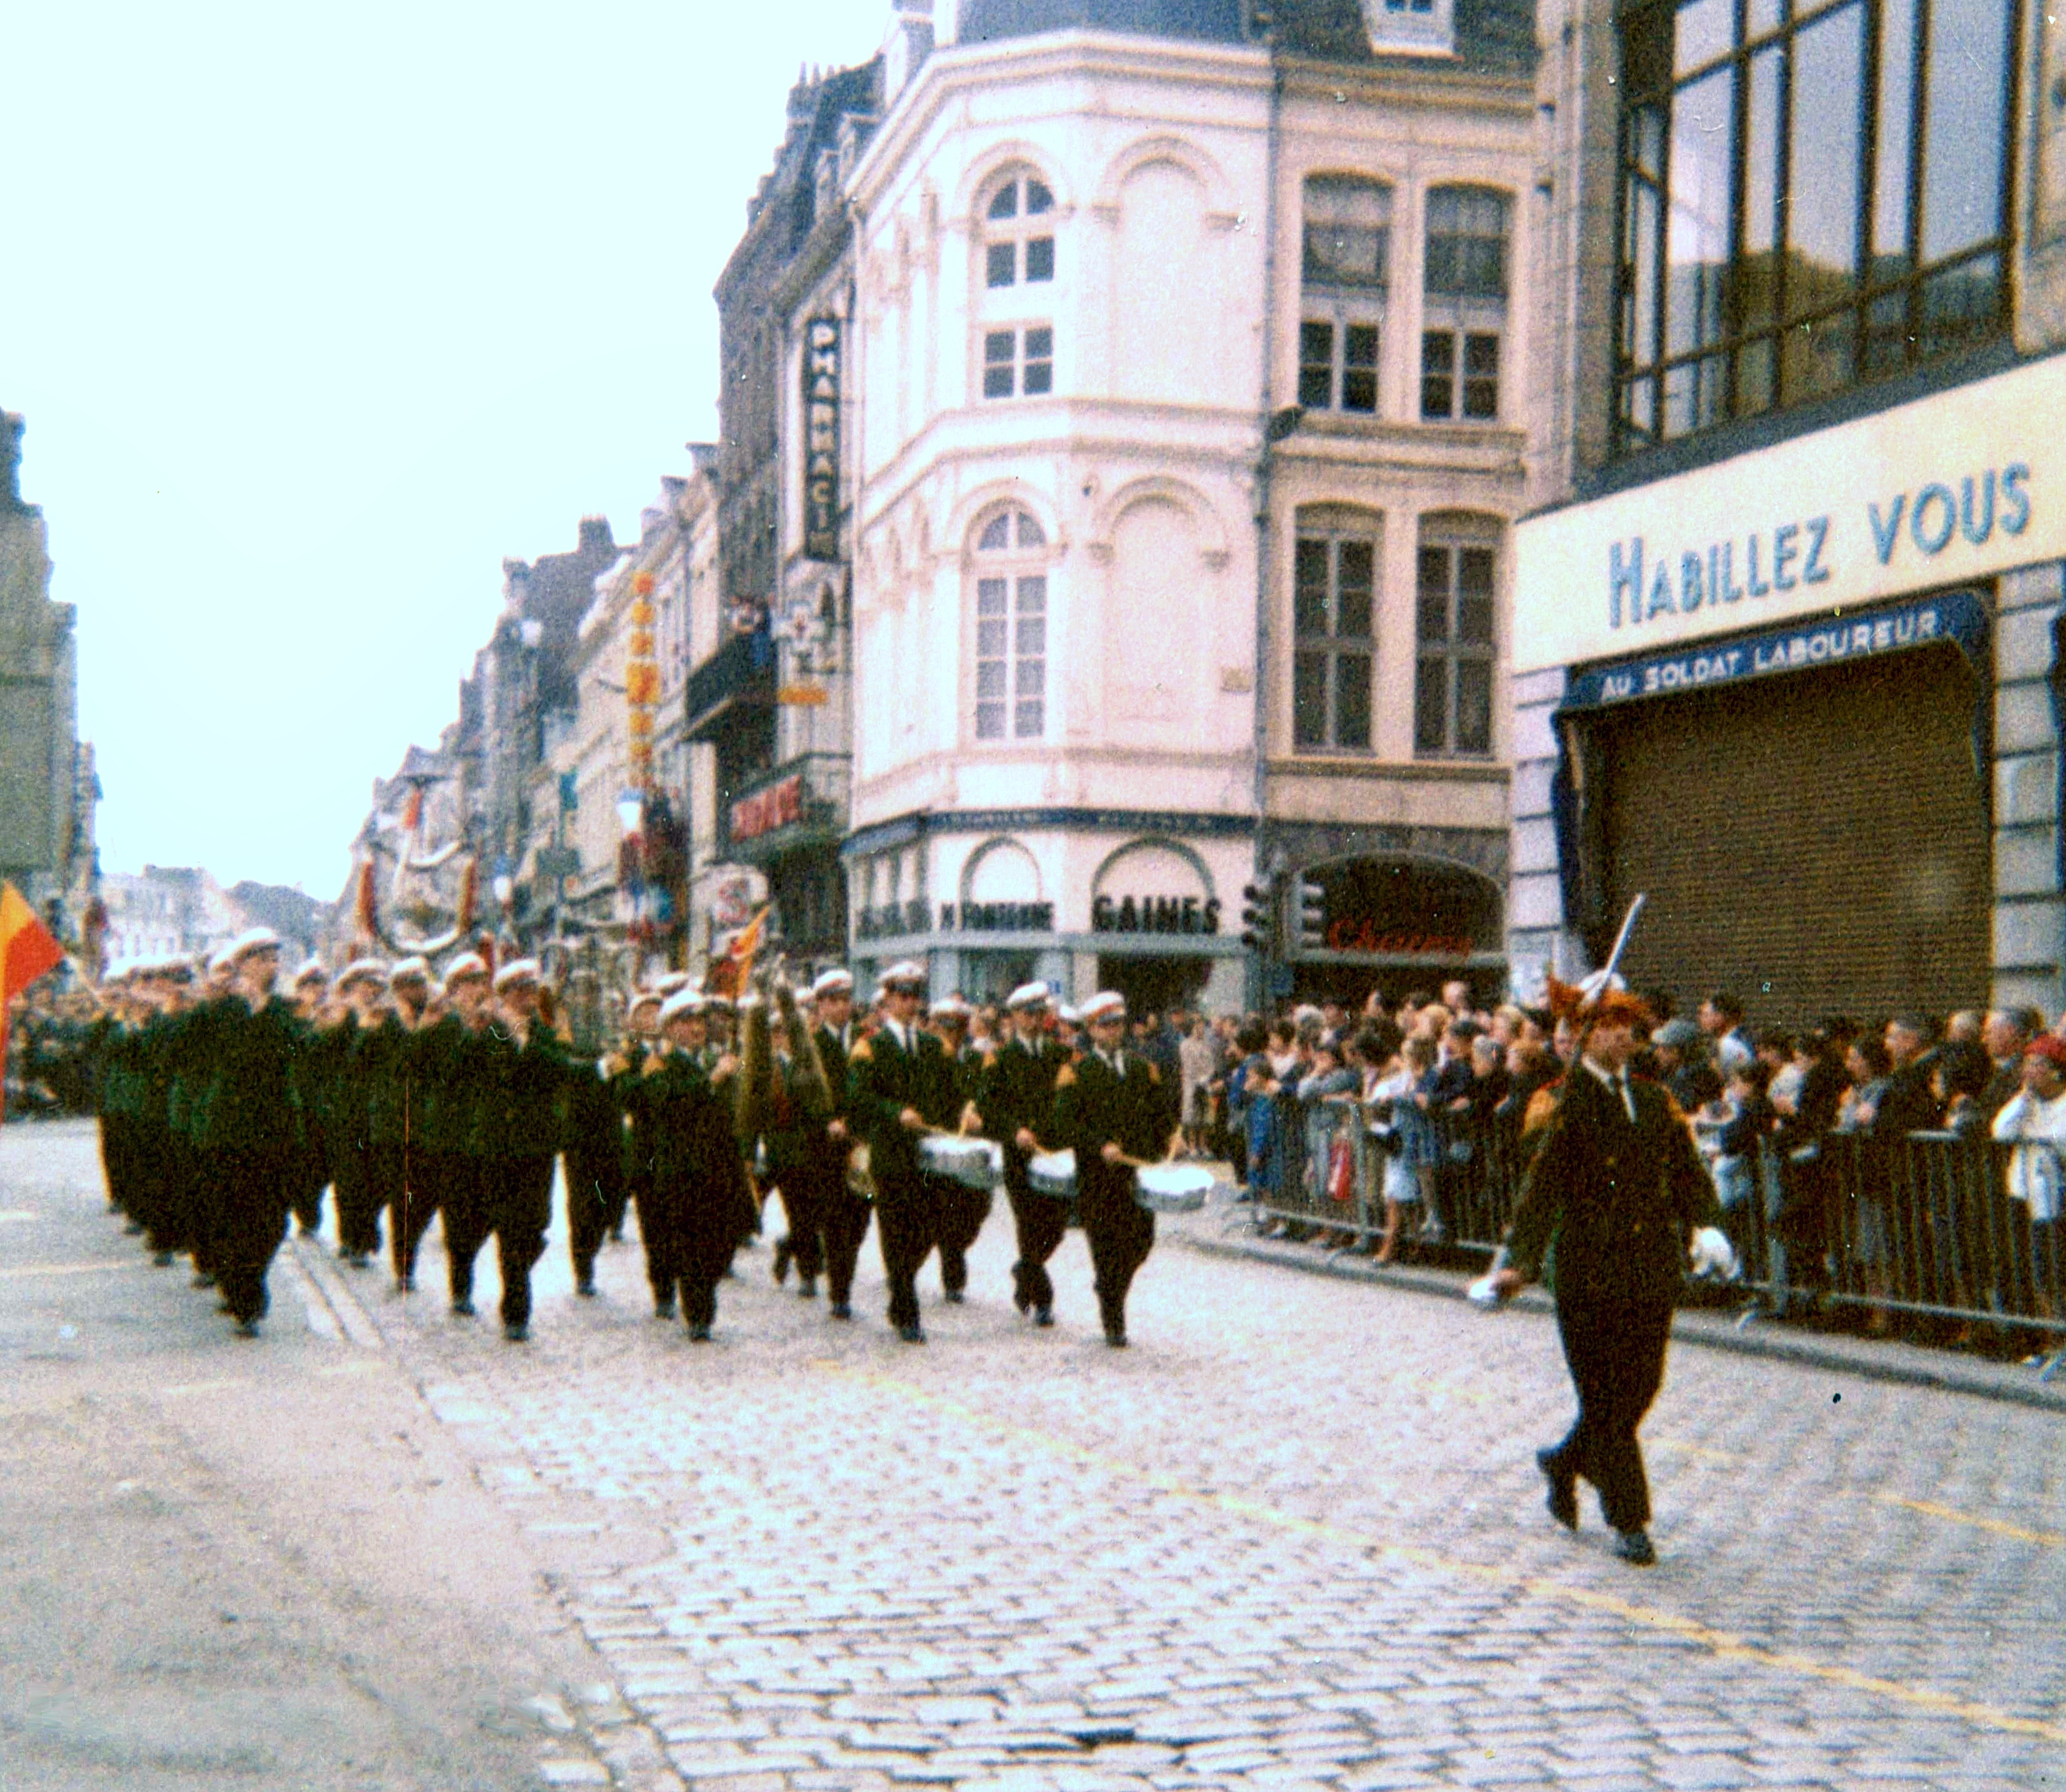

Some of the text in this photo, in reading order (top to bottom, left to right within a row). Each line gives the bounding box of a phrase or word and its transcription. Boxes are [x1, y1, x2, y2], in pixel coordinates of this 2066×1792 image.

[1608, 461, 2031, 630] HABILLEZ VOUS
[1599, 610, 1937, 702] AU SOLDAT LABOUREUR
[1092, 893, 1222, 934] GAINES
